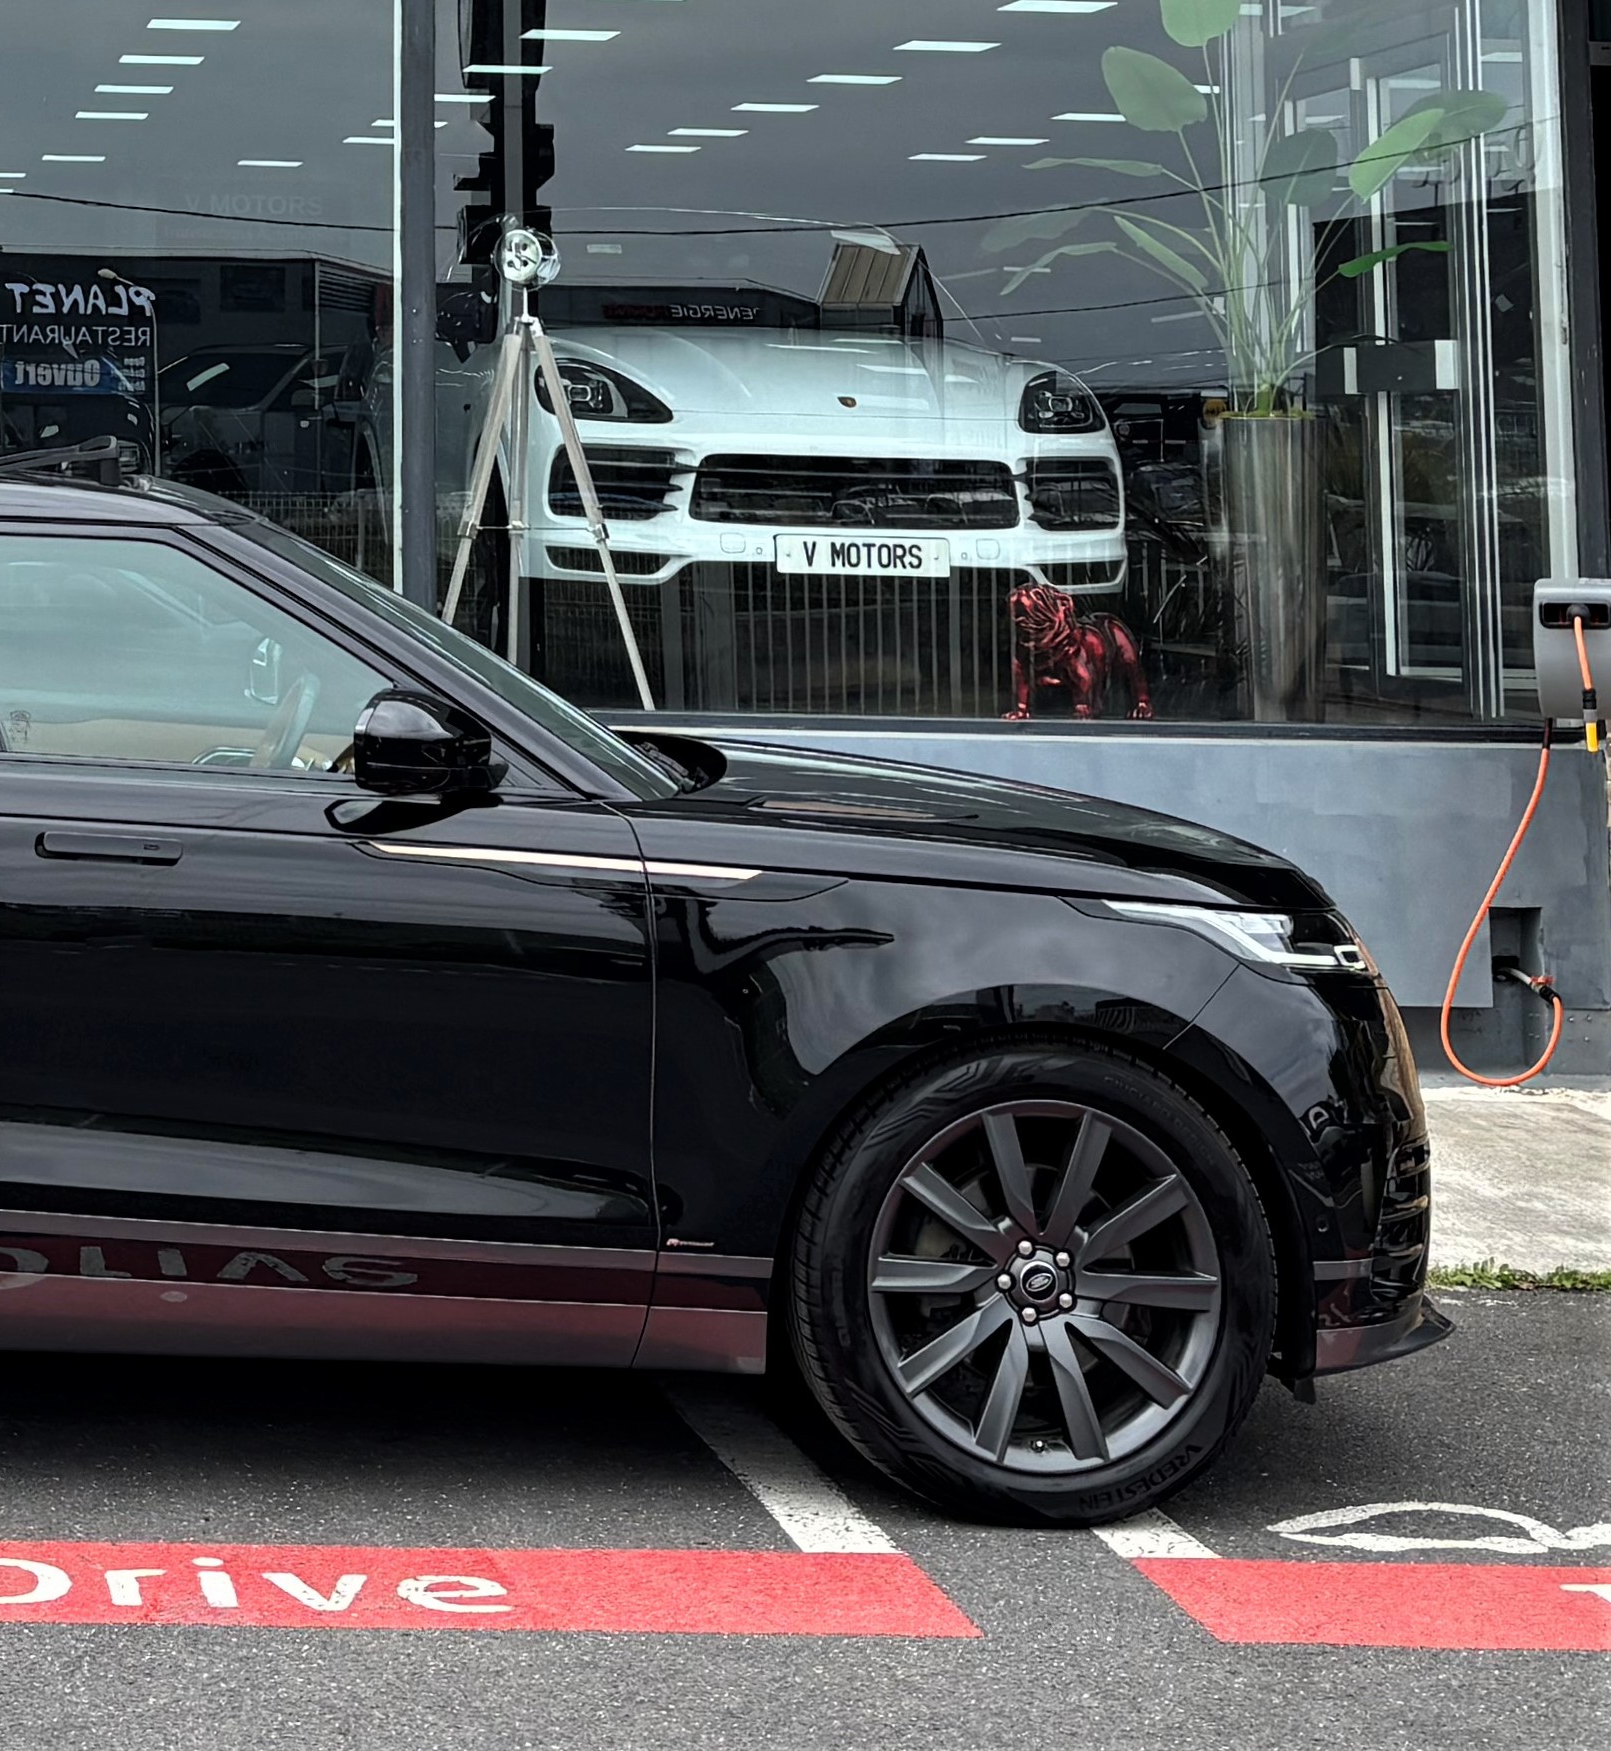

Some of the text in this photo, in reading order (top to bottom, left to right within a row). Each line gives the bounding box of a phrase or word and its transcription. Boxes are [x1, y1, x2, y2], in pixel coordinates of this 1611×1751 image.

[210, 194, 323, 216] MOTORS
[803, 541, 923, 569] V MOTORS
[1078, 1443, 1204, 1510] VREDESTEIN
